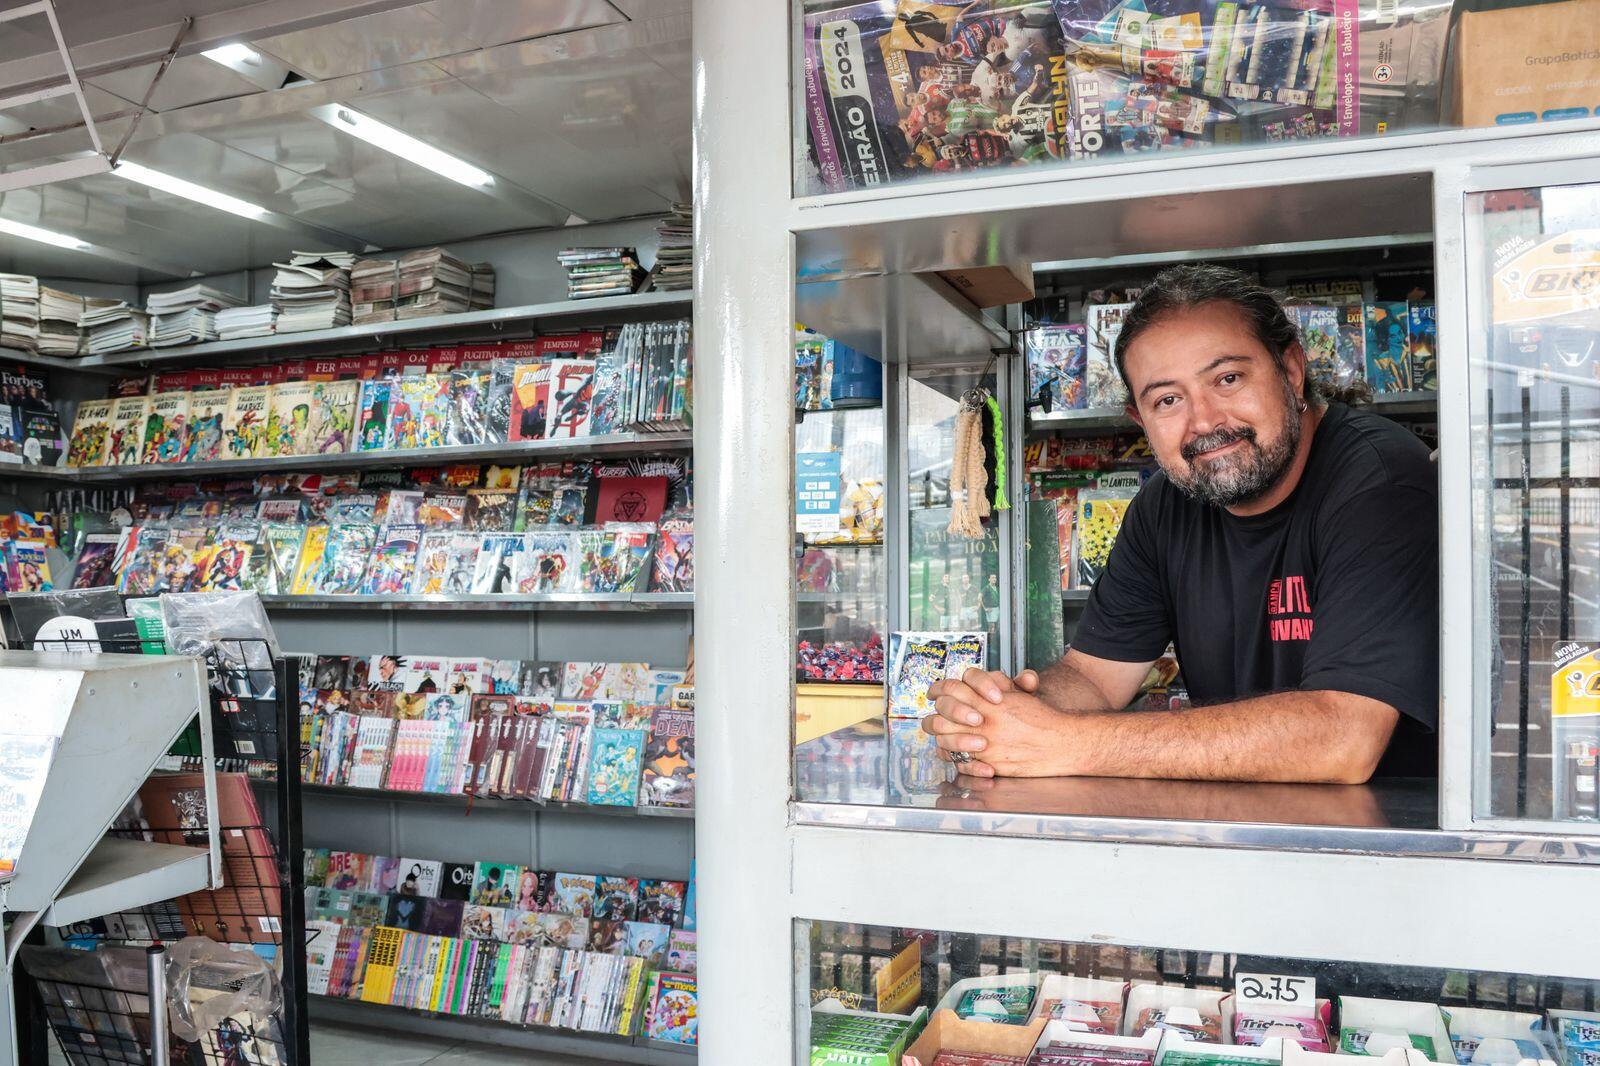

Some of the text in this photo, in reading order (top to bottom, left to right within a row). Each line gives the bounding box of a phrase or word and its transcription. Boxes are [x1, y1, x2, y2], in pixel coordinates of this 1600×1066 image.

[1342, 10, 1353, 57] Tabuleiro
[834, 26, 856, 91] 2024
[805, 57, 818, 99] Tabuleiro
[1342, 72, 1353, 120] Envelopes
[813, 107, 827, 146] Envelopes
[1496, 235, 1524, 257] NOVA
[1, 371, 44, 389] Forbes
[315, 363, 336, 373] FER
[59, 629, 82, 640] UM
[1555, 642, 1580, 659] NOVA
[973, 991, 1014, 1002] Trident
[1241, 976, 1306, 1002] 2,75
